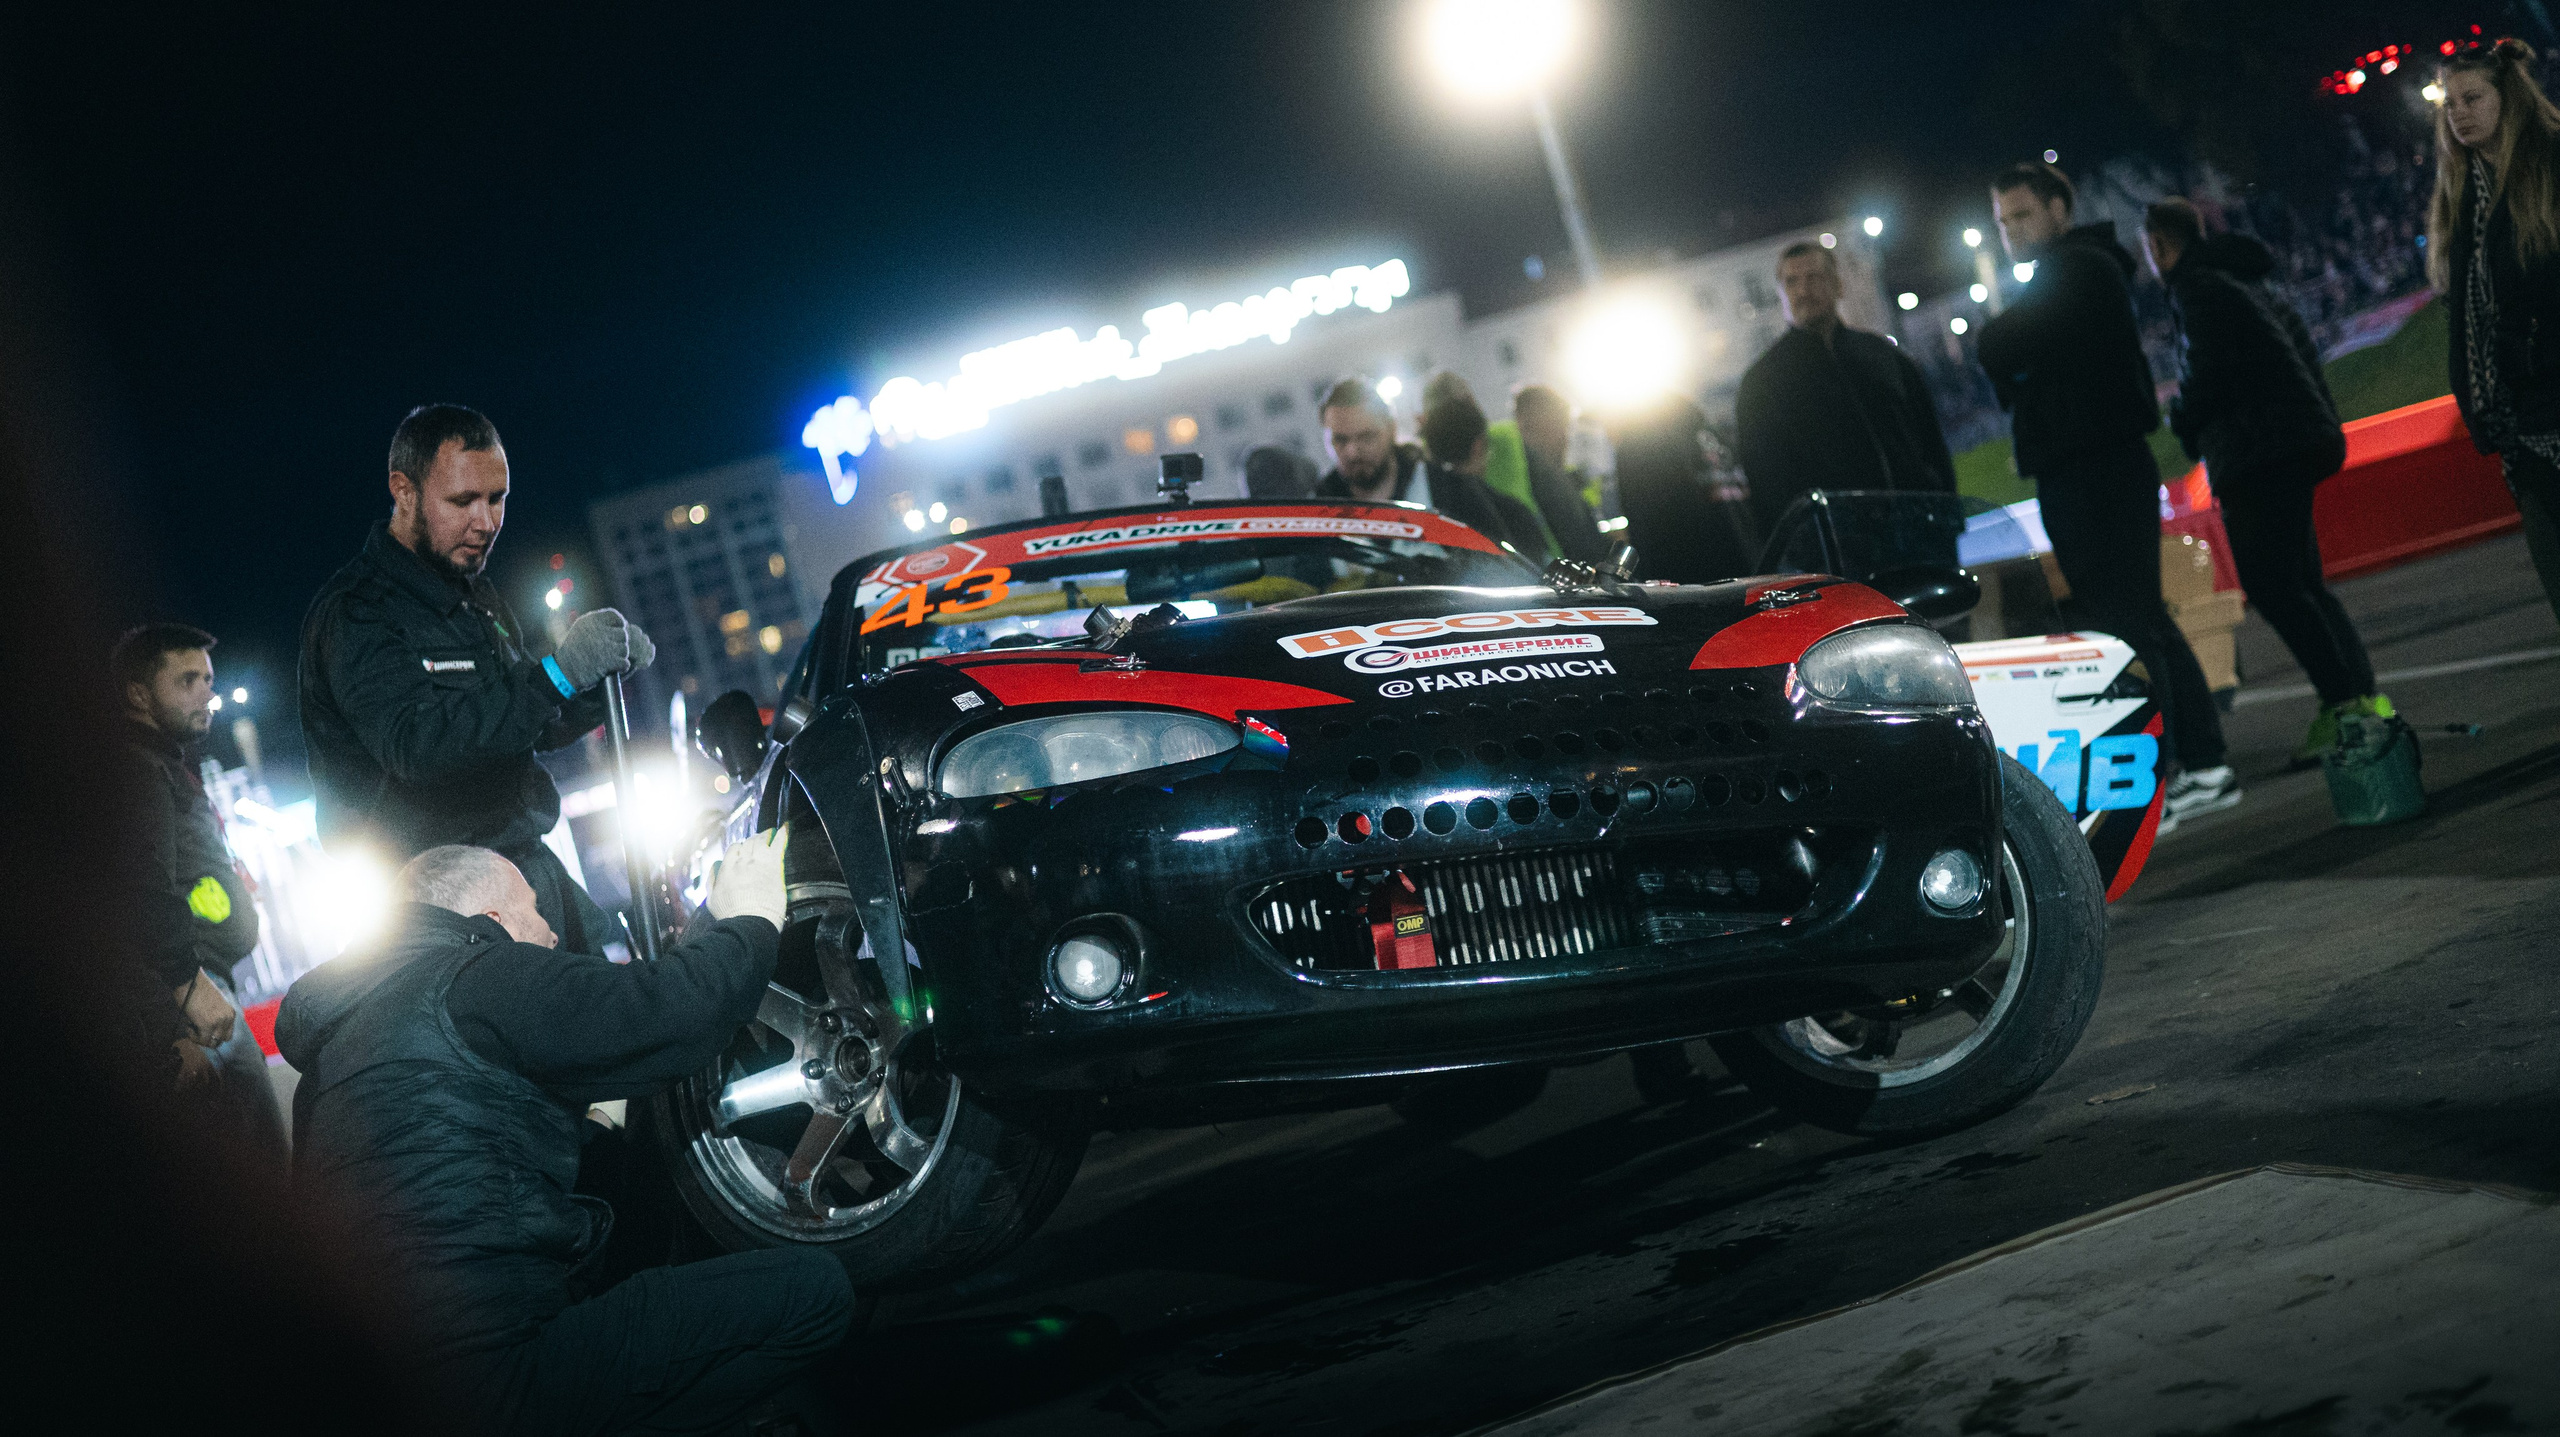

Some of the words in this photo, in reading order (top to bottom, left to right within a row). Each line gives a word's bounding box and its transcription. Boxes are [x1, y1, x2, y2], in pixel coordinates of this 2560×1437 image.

[1030, 530, 1126, 550] YUKA
[1129, 521, 1235, 538] DRIVE
[859, 566, 1012, 636] 43
[1374, 608, 1644, 639] CORE
[1412, 636, 1592, 661] ШИНСЕРВИС
[1415, 648, 1533, 664] АВТОСЕРВИСНЫЕ
[1541, 644, 1594, 653] ЦЕНТРЫ
[1378, 659, 1617, 698] @FARAONICH
[1397, 917, 1424, 931] OMP
